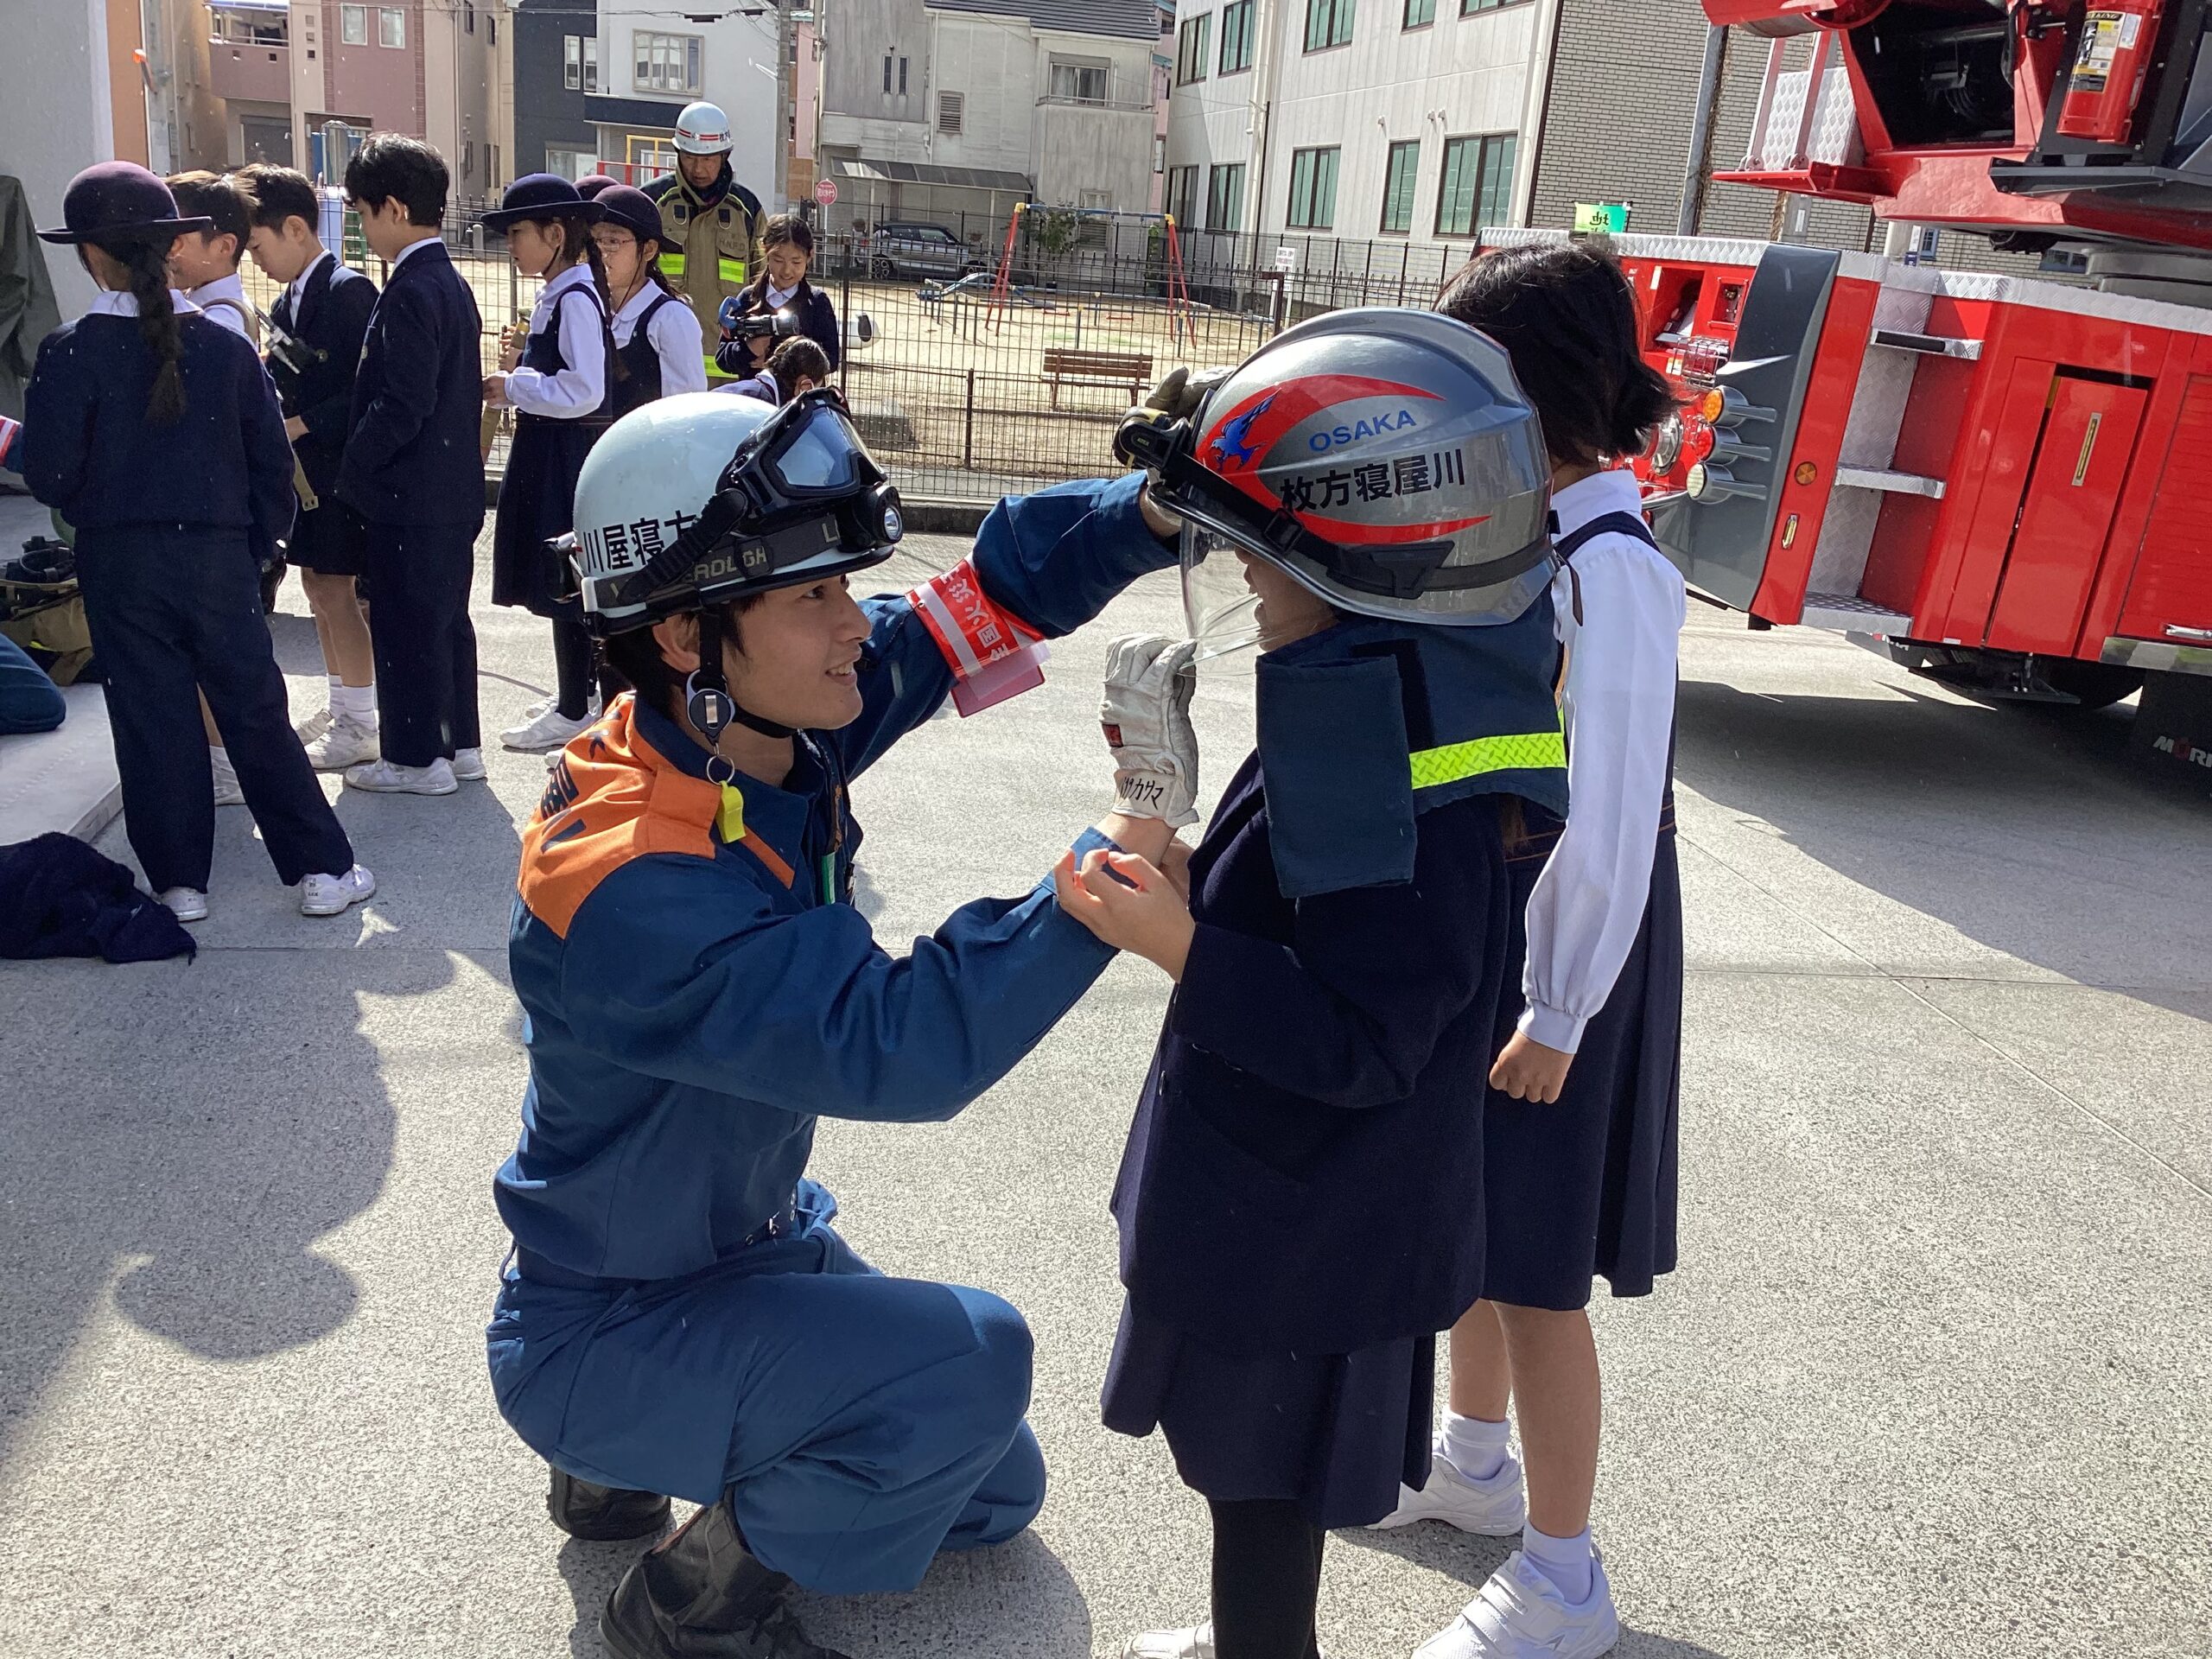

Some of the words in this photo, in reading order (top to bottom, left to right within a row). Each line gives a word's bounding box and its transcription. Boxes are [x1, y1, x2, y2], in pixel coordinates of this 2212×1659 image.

[1309, 410, 1417, 452] OSAKA
[1281, 448, 1465, 512] 枚方寝屋川
